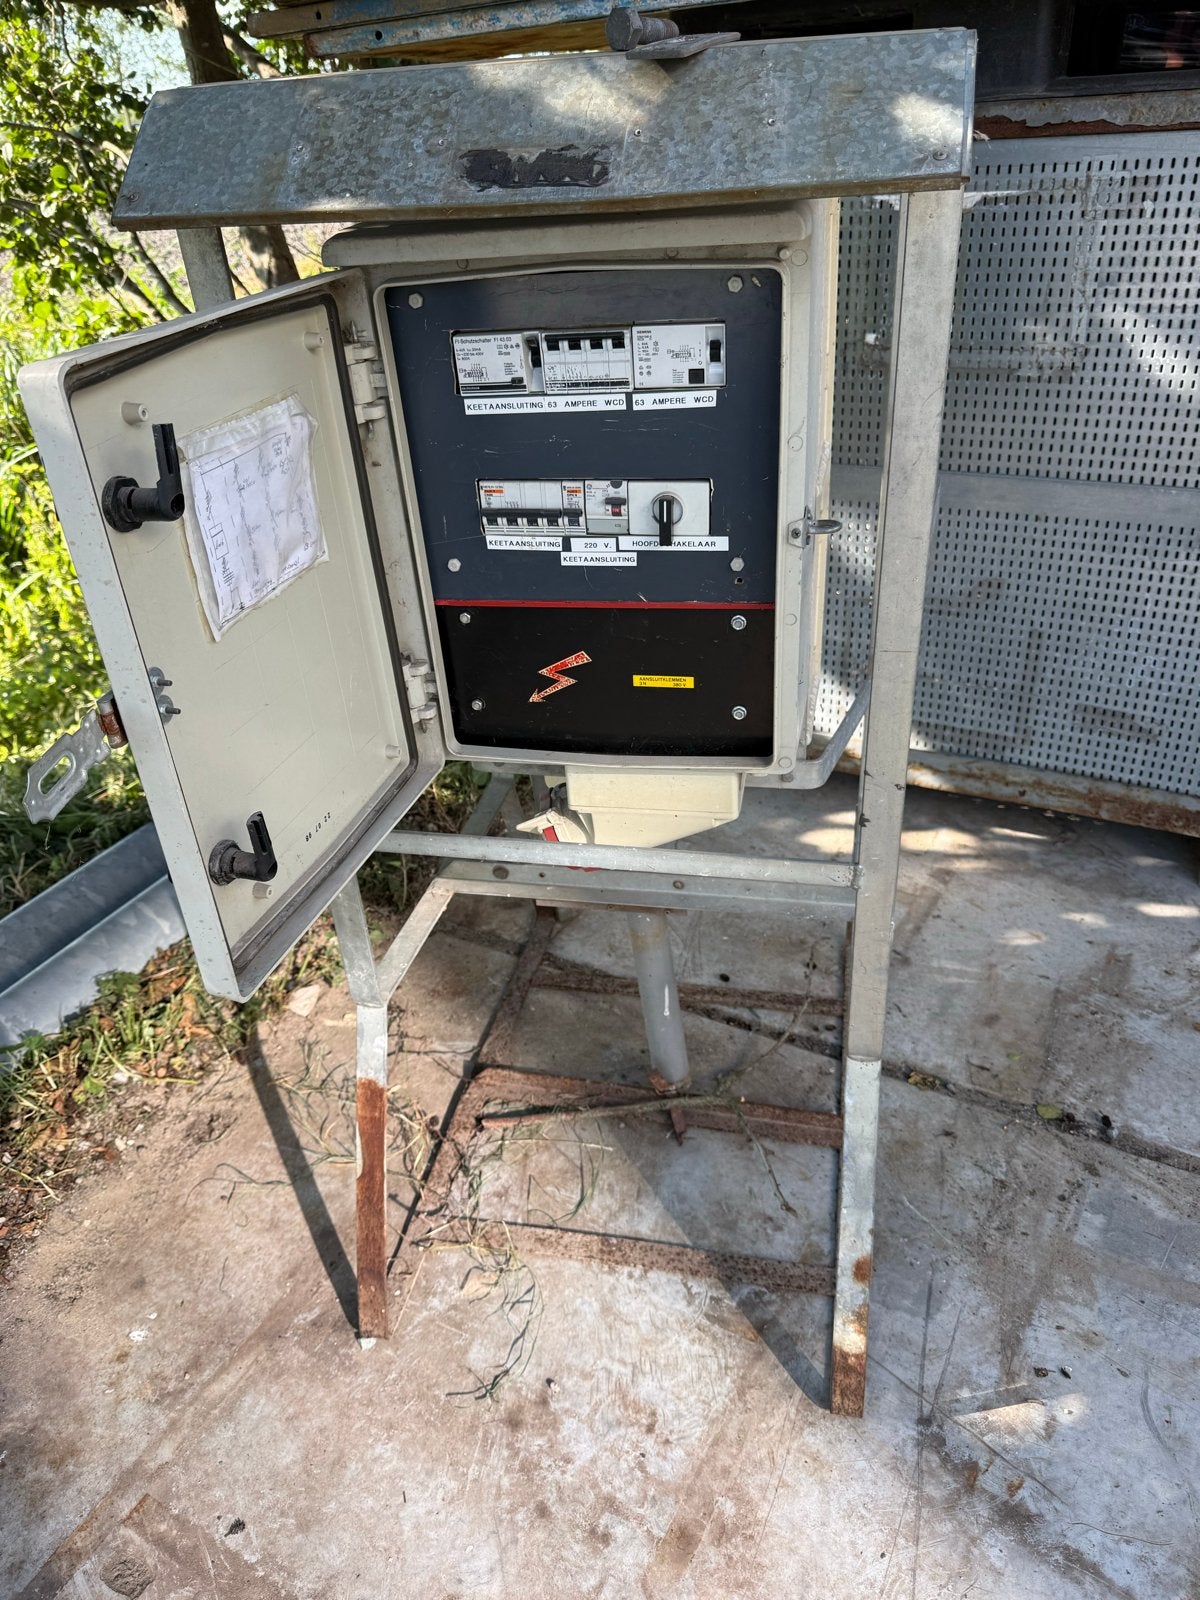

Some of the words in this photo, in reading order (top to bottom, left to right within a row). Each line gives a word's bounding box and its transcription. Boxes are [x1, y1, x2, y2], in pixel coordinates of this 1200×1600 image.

[466, 401, 544, 410] KEETAANSLUITING
[564, 400, 597, 408] AMPERE
[604, 398, 625, 406] WCD
[652, 397, 687, 405] AMPERE
[693, 395, 714, 403] WCD
[488, 540, 561, 548] KEETAANSLUITING
[632, 540, 717, 548] HOOFDHAKELAAR
